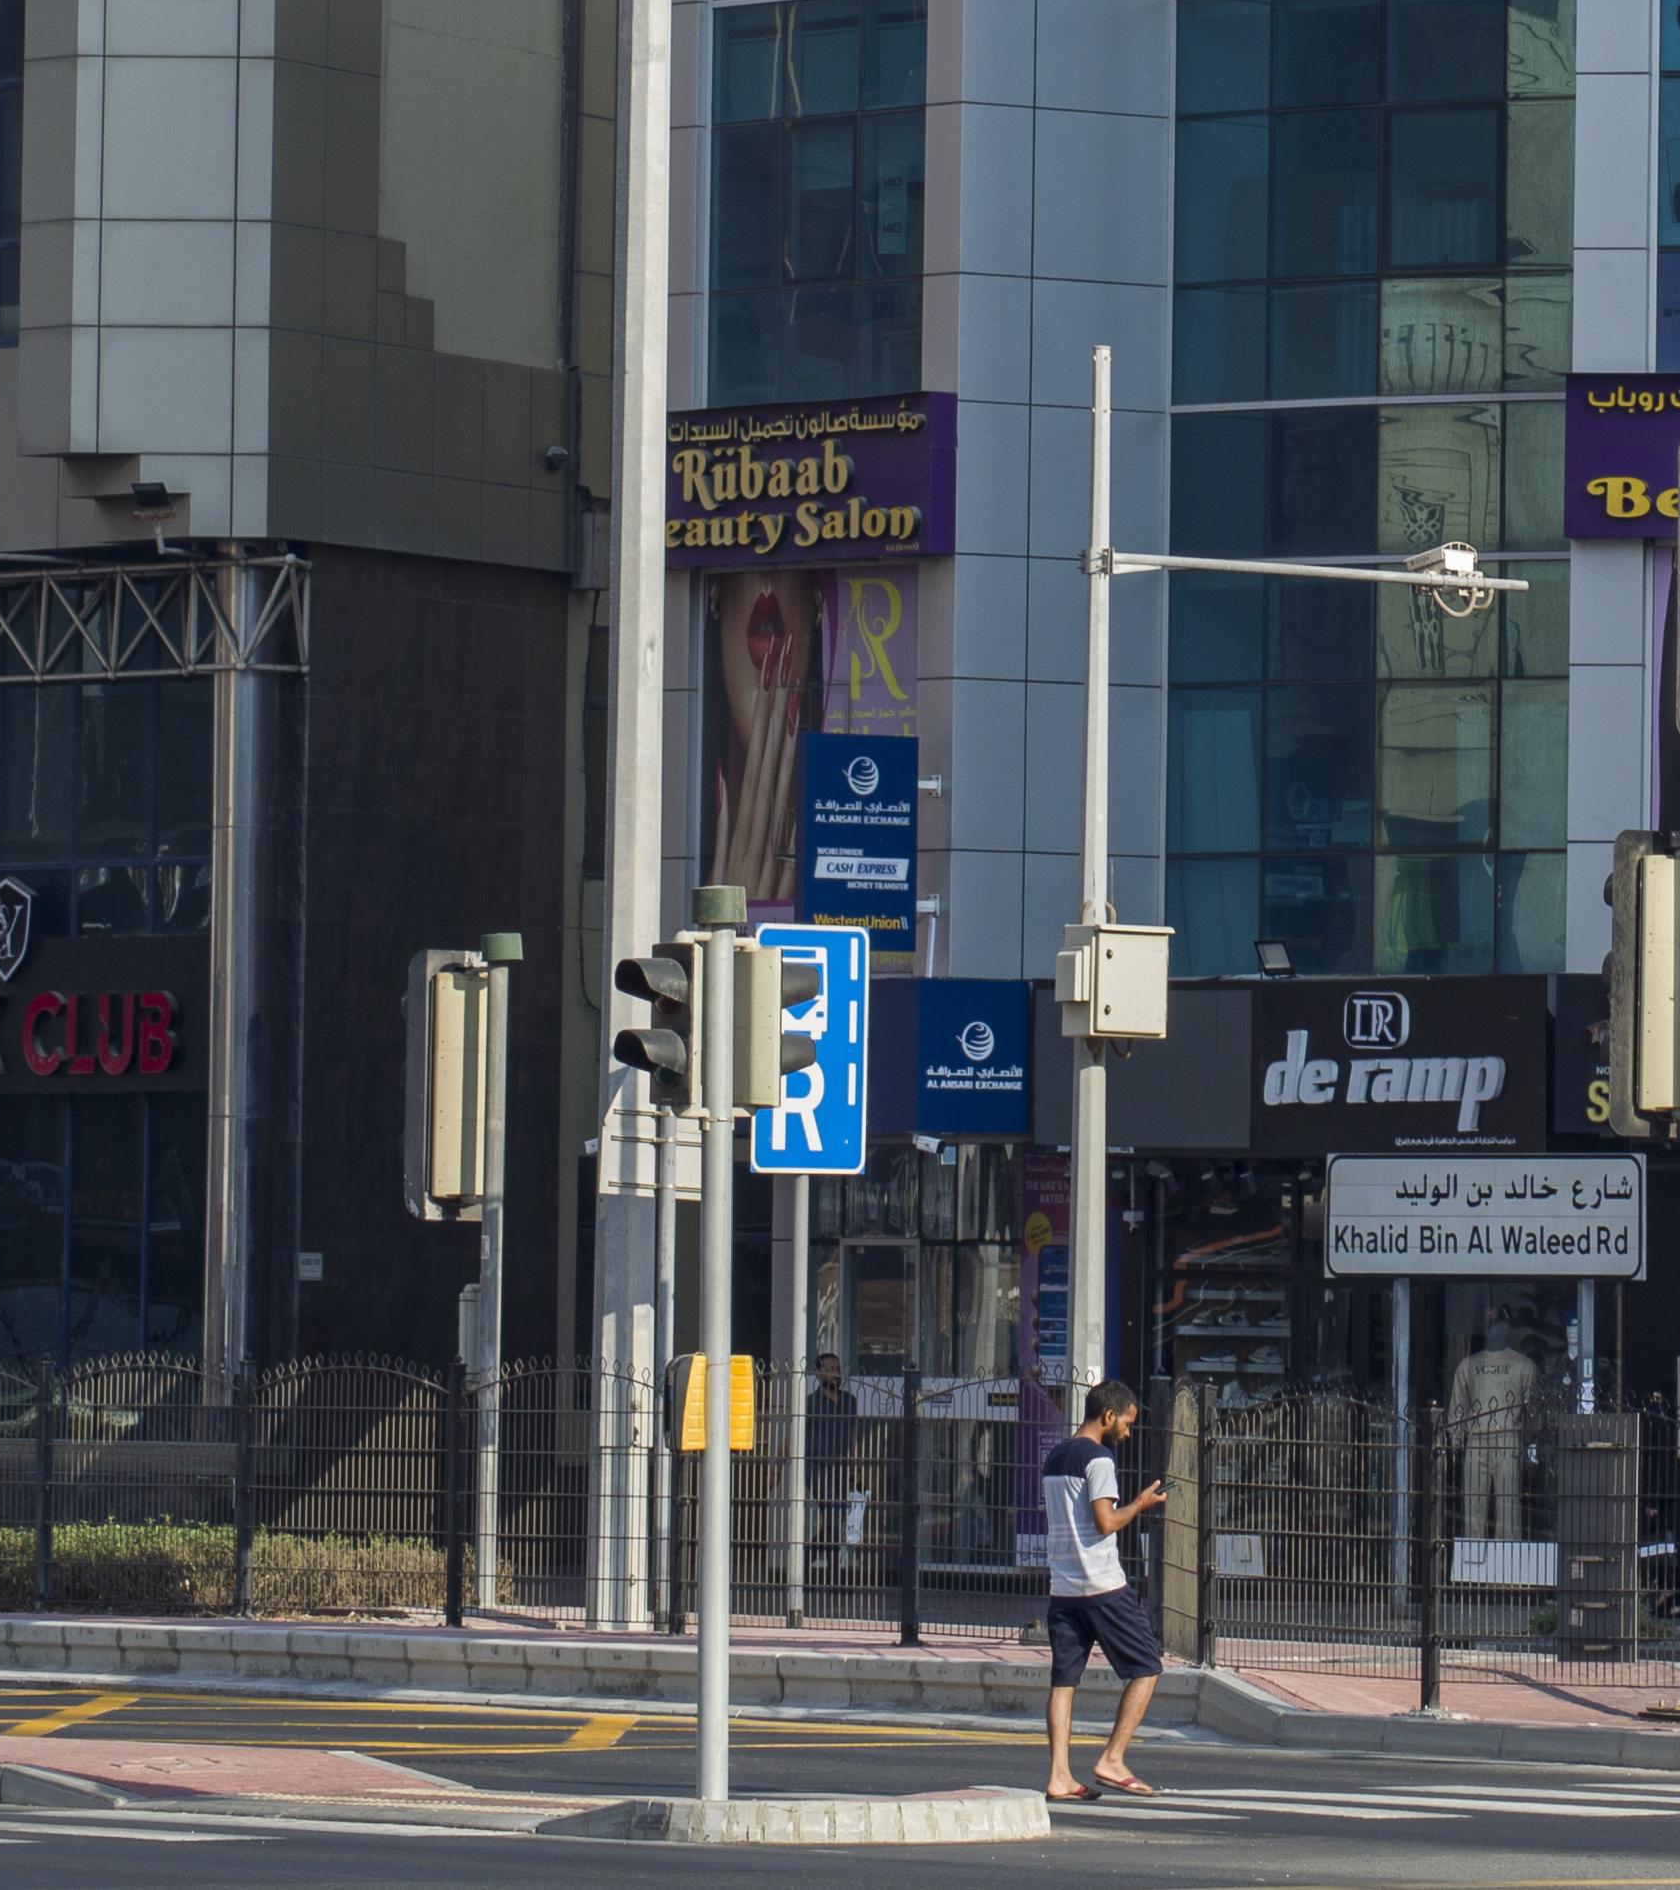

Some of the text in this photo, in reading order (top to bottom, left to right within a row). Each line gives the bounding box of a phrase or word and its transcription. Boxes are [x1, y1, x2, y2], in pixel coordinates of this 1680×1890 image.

[672, 438, 848, 510] Rübaab
[665, 496, 915, 554] eauty Salon
[815, 814, 911, 826] AL ANSARI EXCHANGE
[826, 861, 898, 875] CASH EXPRESS
[23, 990, 175, 1077] CLUB
[926, 1079, 1023, 1091] AL ANSARI EXCHANGE
[1263, 1029, 1339, 1106] de
[1346, 1055, 1507, 1132] ramp
[1395, 1172, 1633, 1209] شارع خالد بن الوليد
[1334, 1225, 1630, 1256] Khalid Bin Al Waleed Rd
